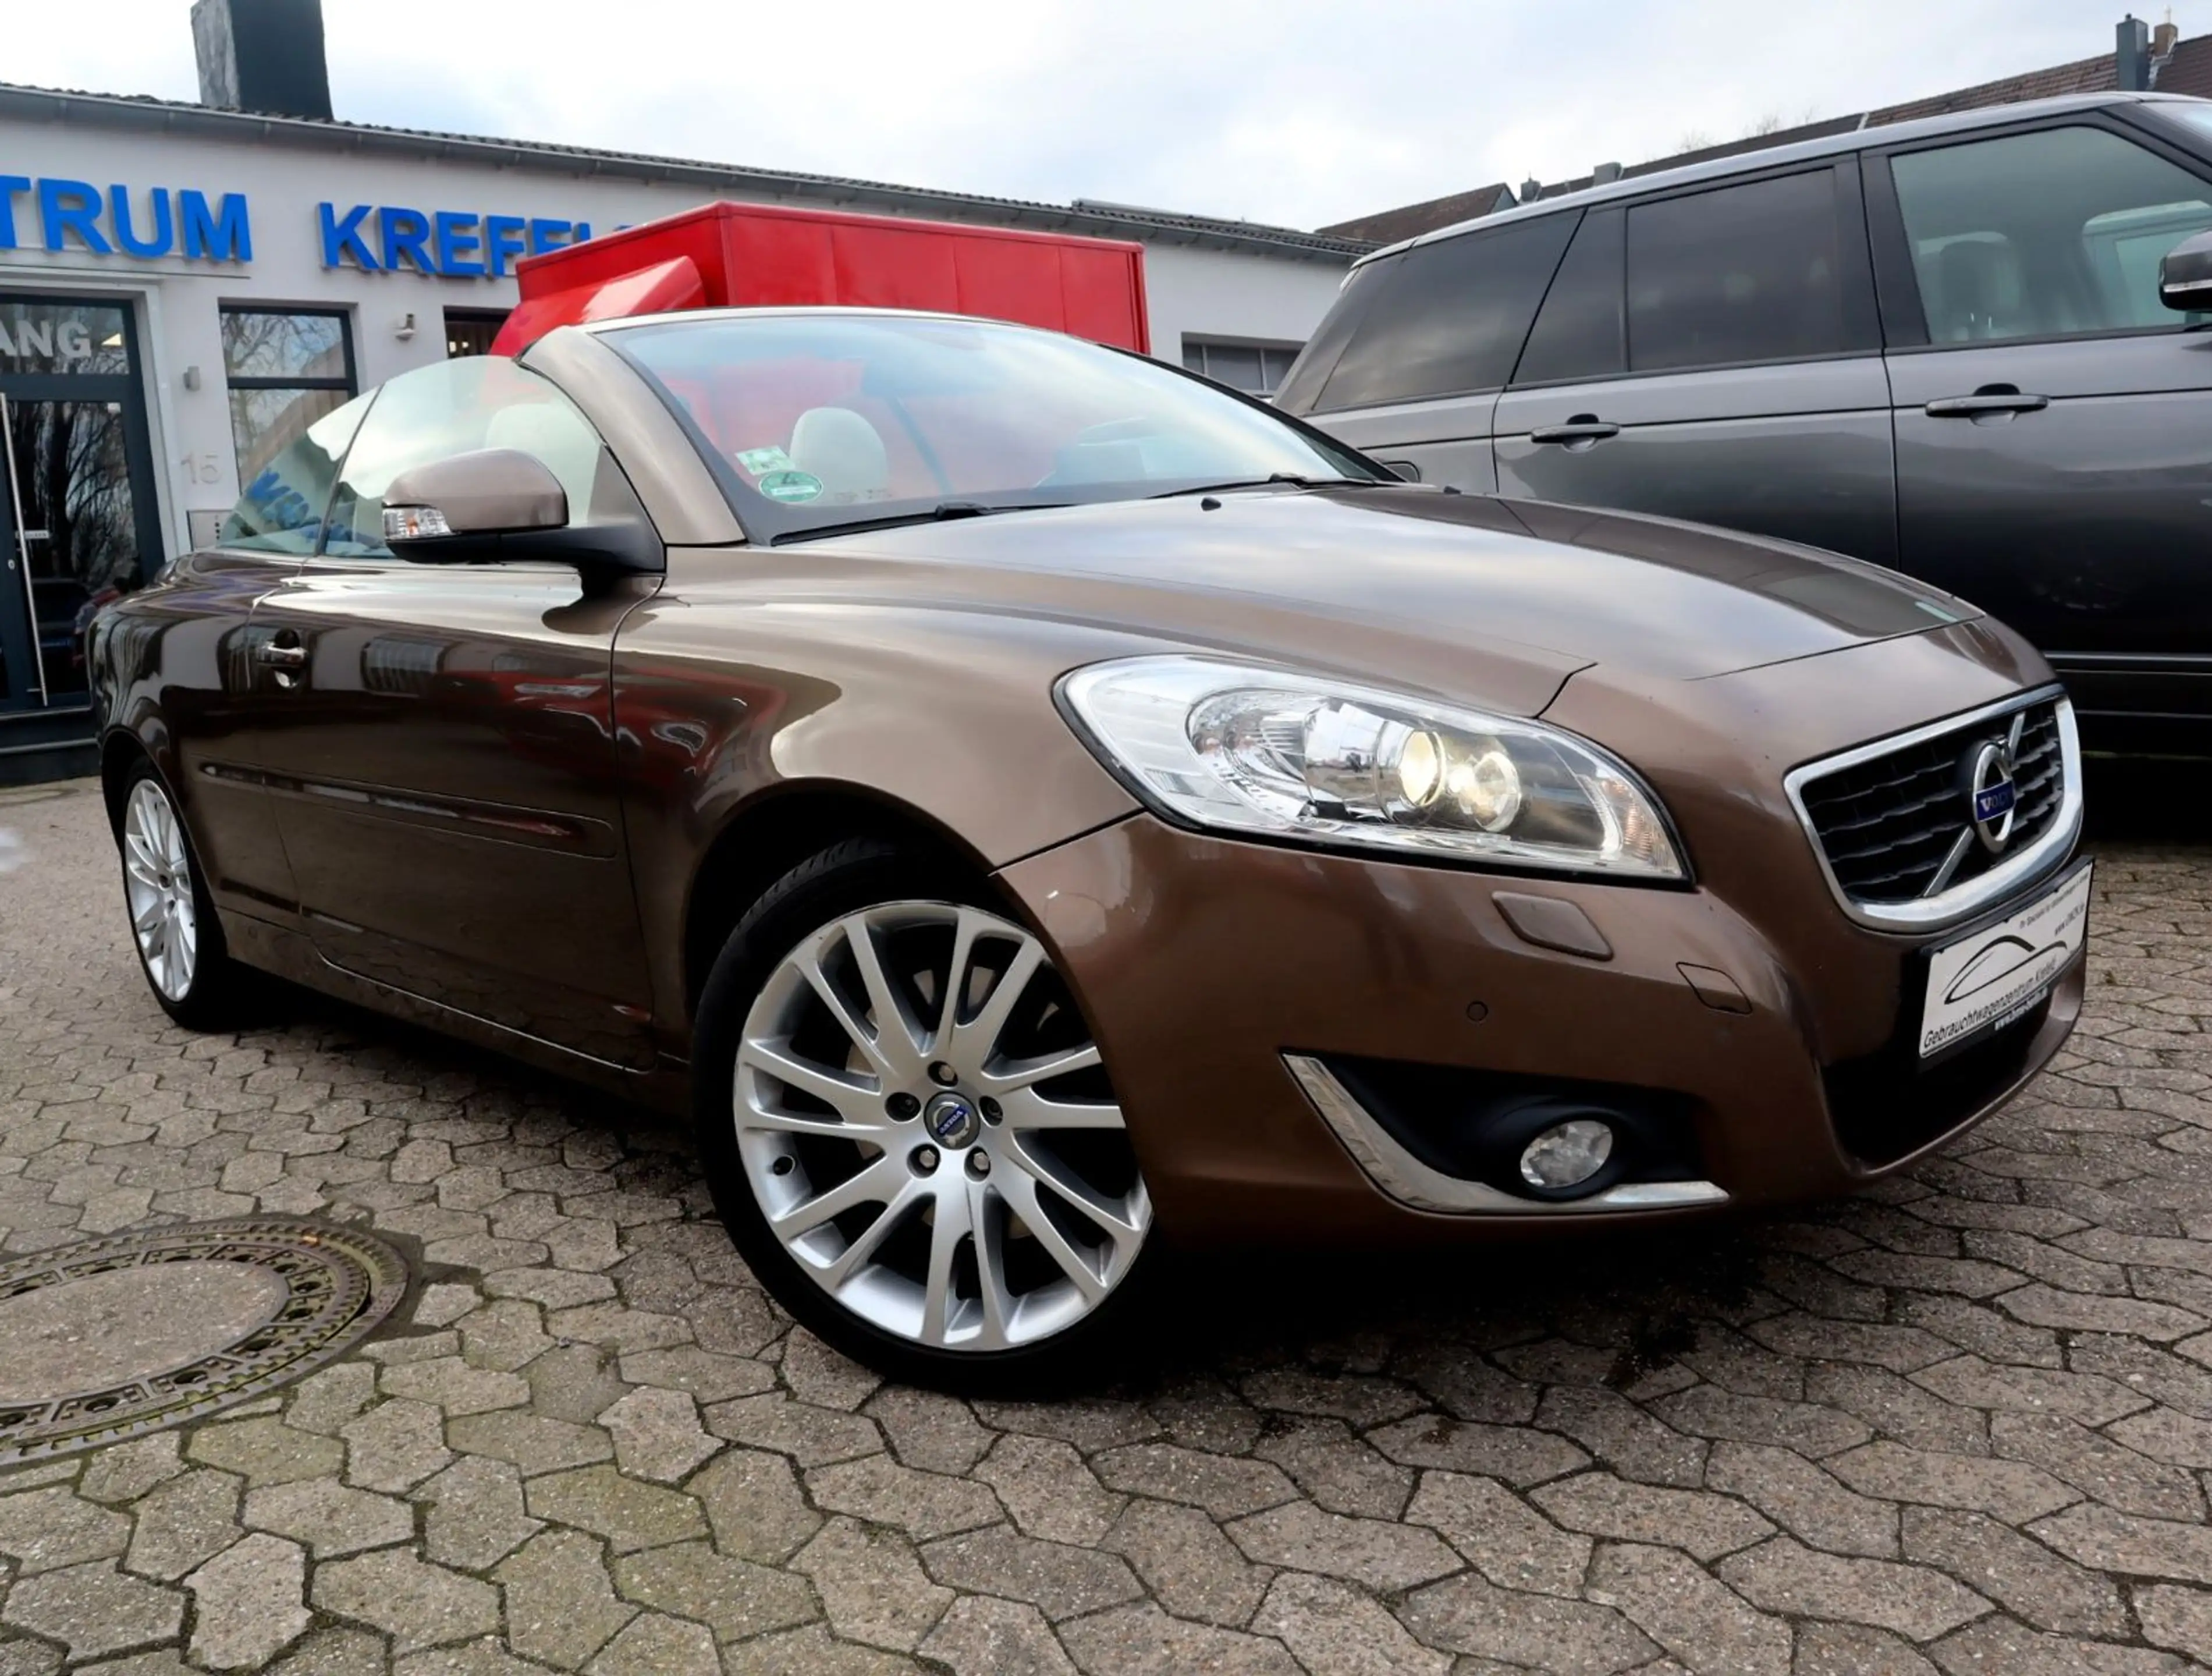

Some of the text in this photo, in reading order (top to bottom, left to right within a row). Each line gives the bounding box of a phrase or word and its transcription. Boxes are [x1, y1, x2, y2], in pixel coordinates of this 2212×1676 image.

[0, 175, 633, 278] TRUM KREFE
[180, 452, 223, 485] 15
